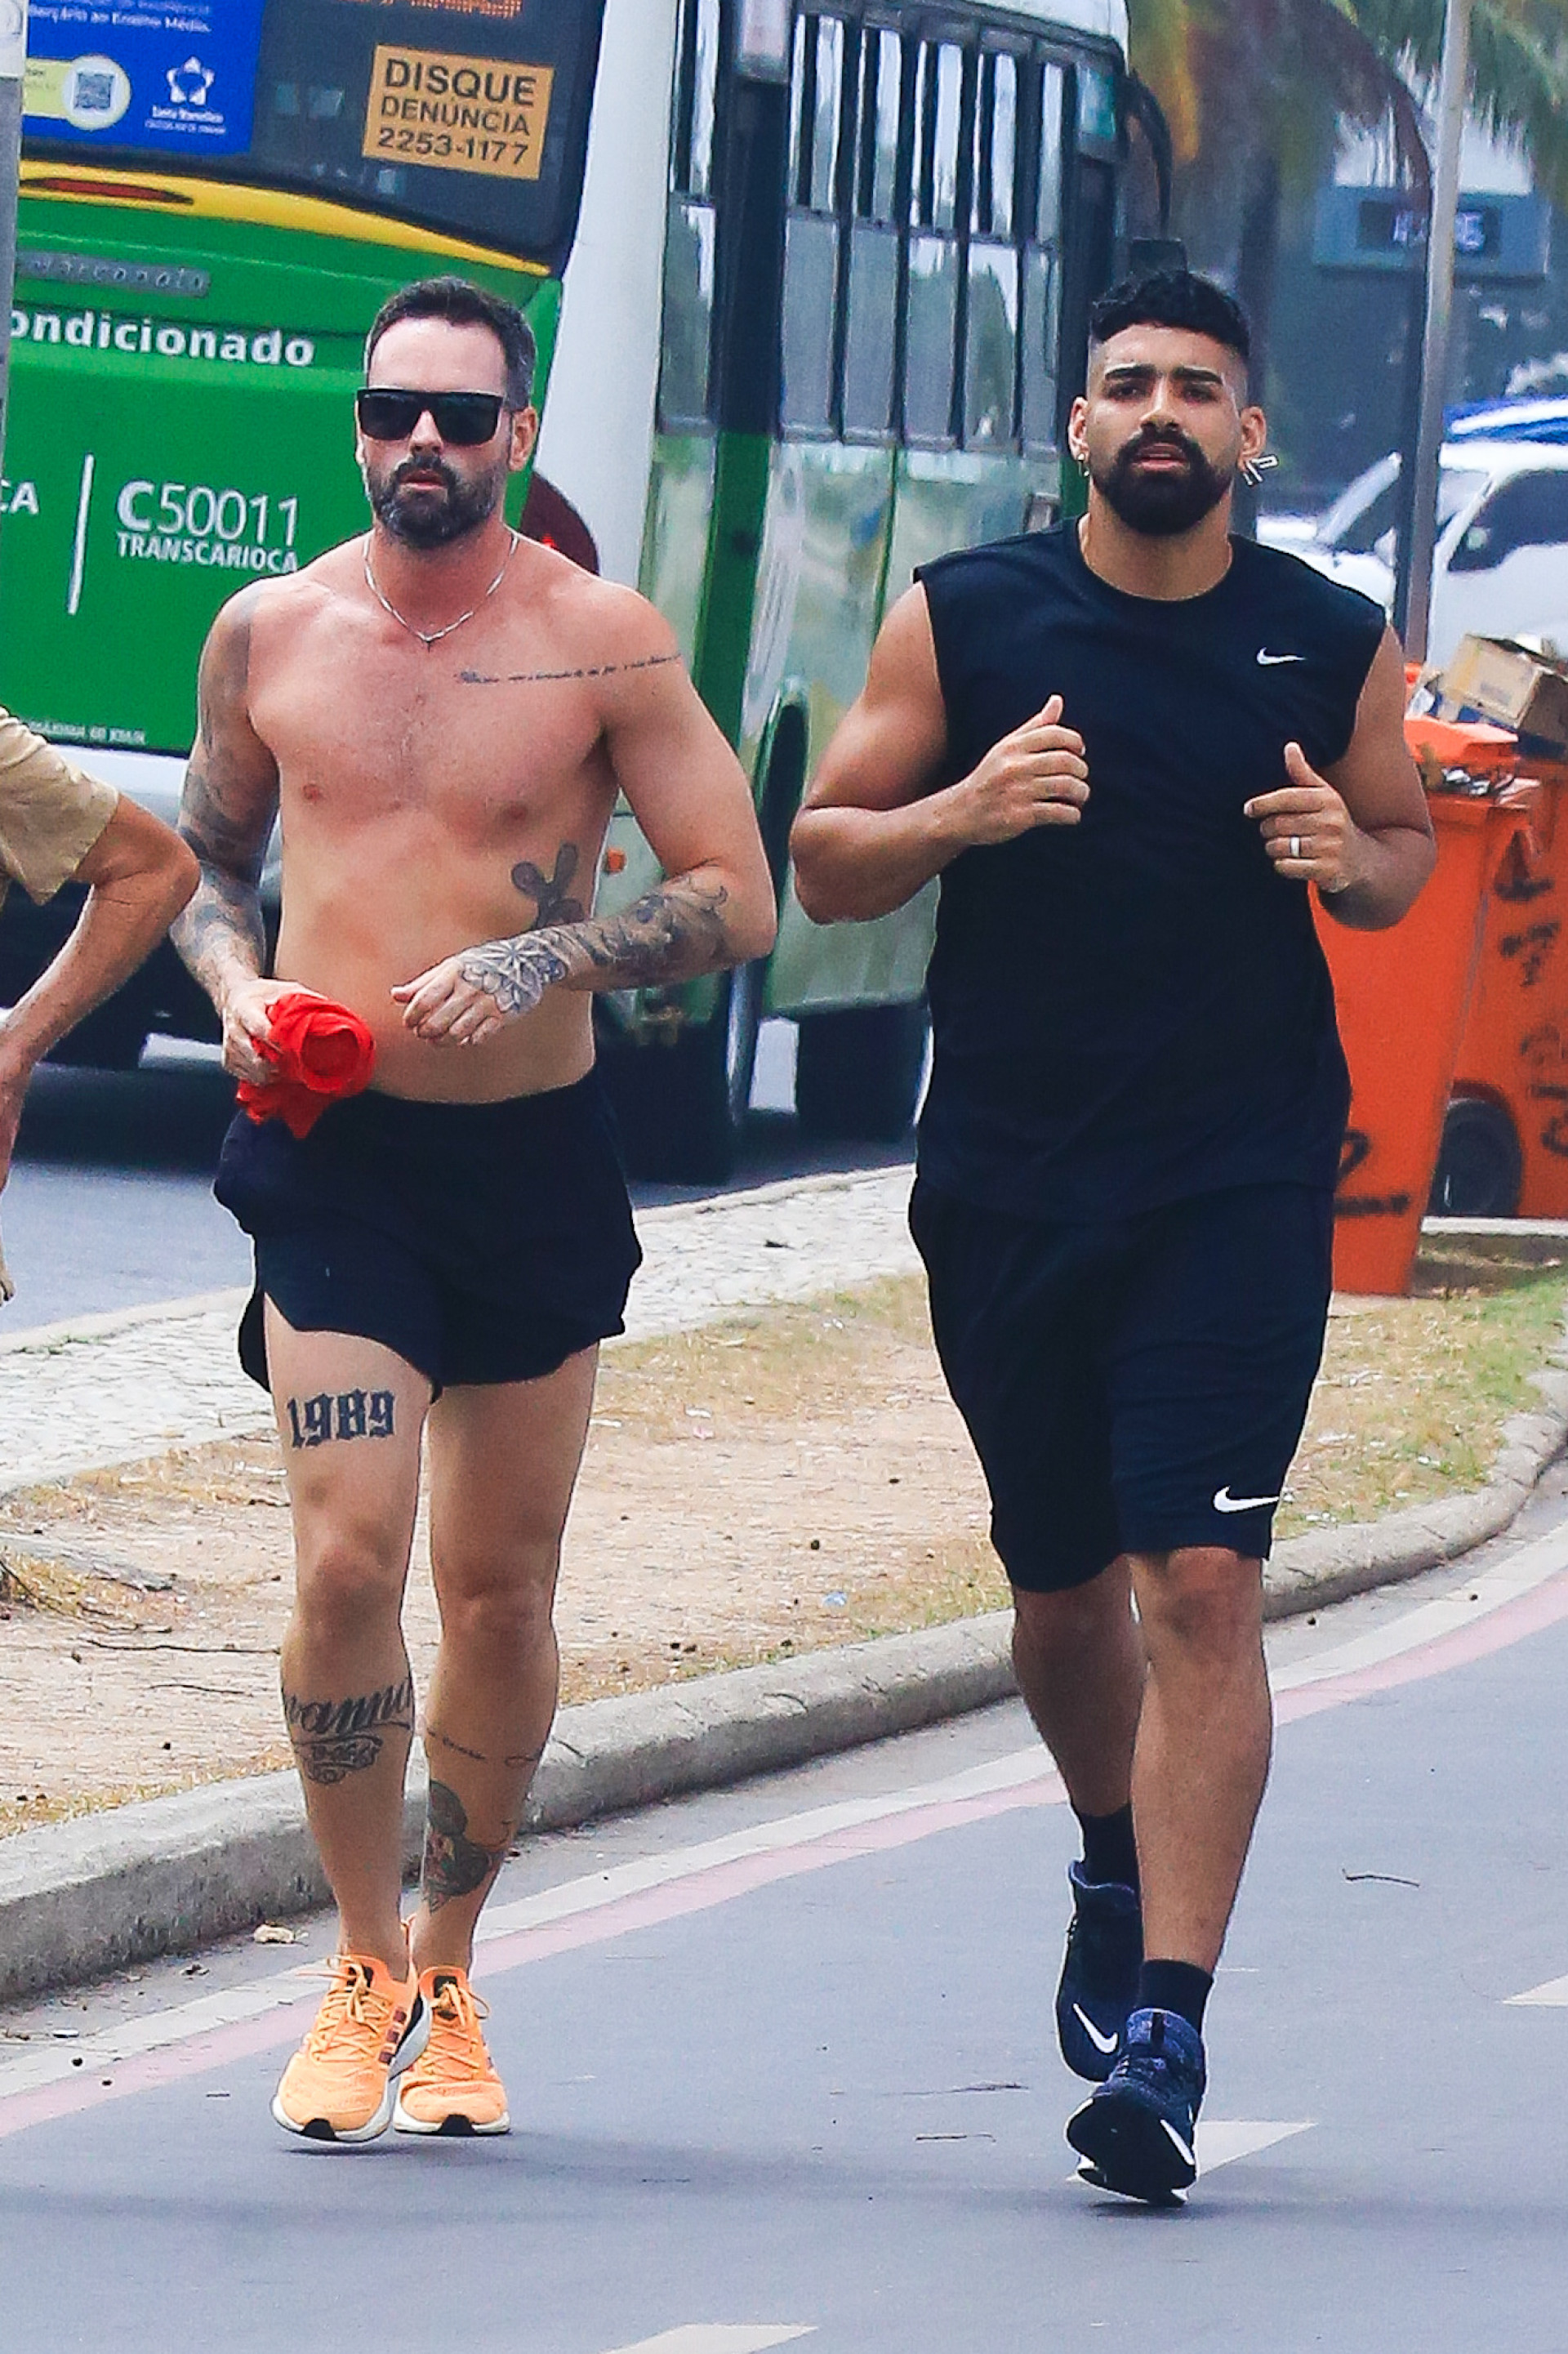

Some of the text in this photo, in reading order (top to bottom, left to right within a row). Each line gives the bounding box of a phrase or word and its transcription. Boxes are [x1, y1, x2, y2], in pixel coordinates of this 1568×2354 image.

[385, 58, 537, 106] DISQUE
[381, 95, 530, 136] DENÚNCIA
[378, 127, 528, 164] 2253-1177
[117, 479, 298, 546] C50011
[116, 529, 298, 573] TRANSCARIOCA
[287, 1388, 395, 1449] 1989
